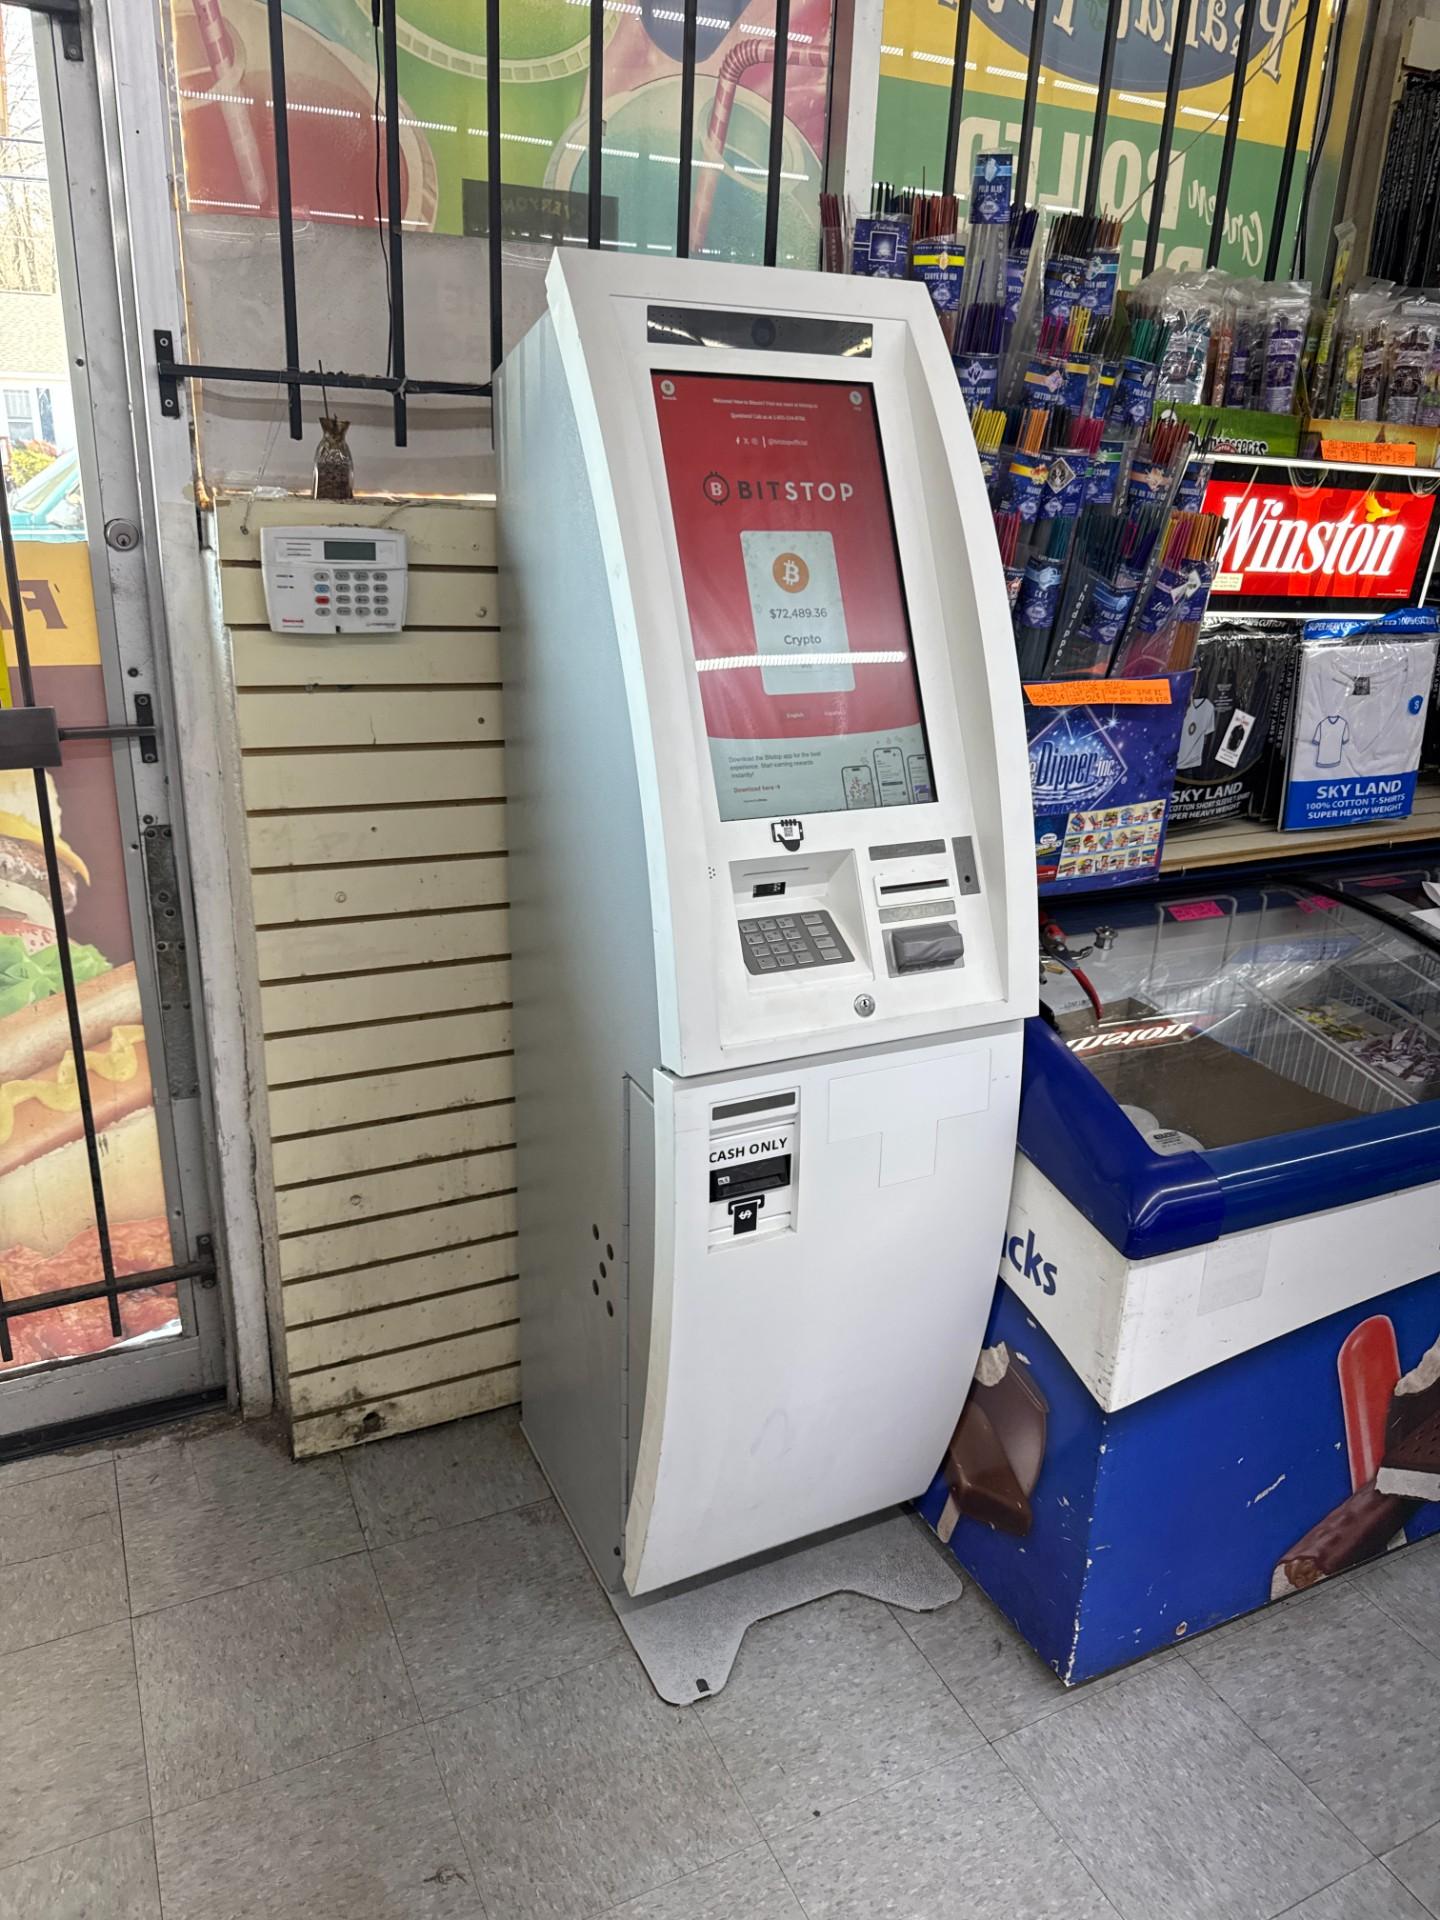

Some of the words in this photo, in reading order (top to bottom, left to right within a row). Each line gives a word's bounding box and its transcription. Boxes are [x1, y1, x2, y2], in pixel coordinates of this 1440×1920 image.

[737, 480, 853, 502] BITSTOP
[1221, 496, 1406, 576] Winston
[769, 607, 828, 620] $72,489.36
[784, 633, 822, 646] Crypto
[1170, 788, 1204, 804] SKY
[1205, 781, 1243, 799] LAND
[1316, 783, 1352, 799] SKY
[1355, 780, 1402, 796] LAND
[1188, 808, 1216, 818] HEAVY
[1215, 801, 1241, 814] WEIGHT
[1305, 802, 1331, 810] 100%
[1331, 798, 1369, 809] COTTON
[1371, 793, 1405, 804] T-SHIRTS
[1307, 810, 1338, 819] SUPER
[1339, 807, 1370, 817] HEAVY
[1371, 803, 1402, 814] WEIGHT
[709, 1146, 745, 1163] CASH
[749, 1137, 788, 1155] ONLY
[1002, 1228, 1057, 1296] cks
